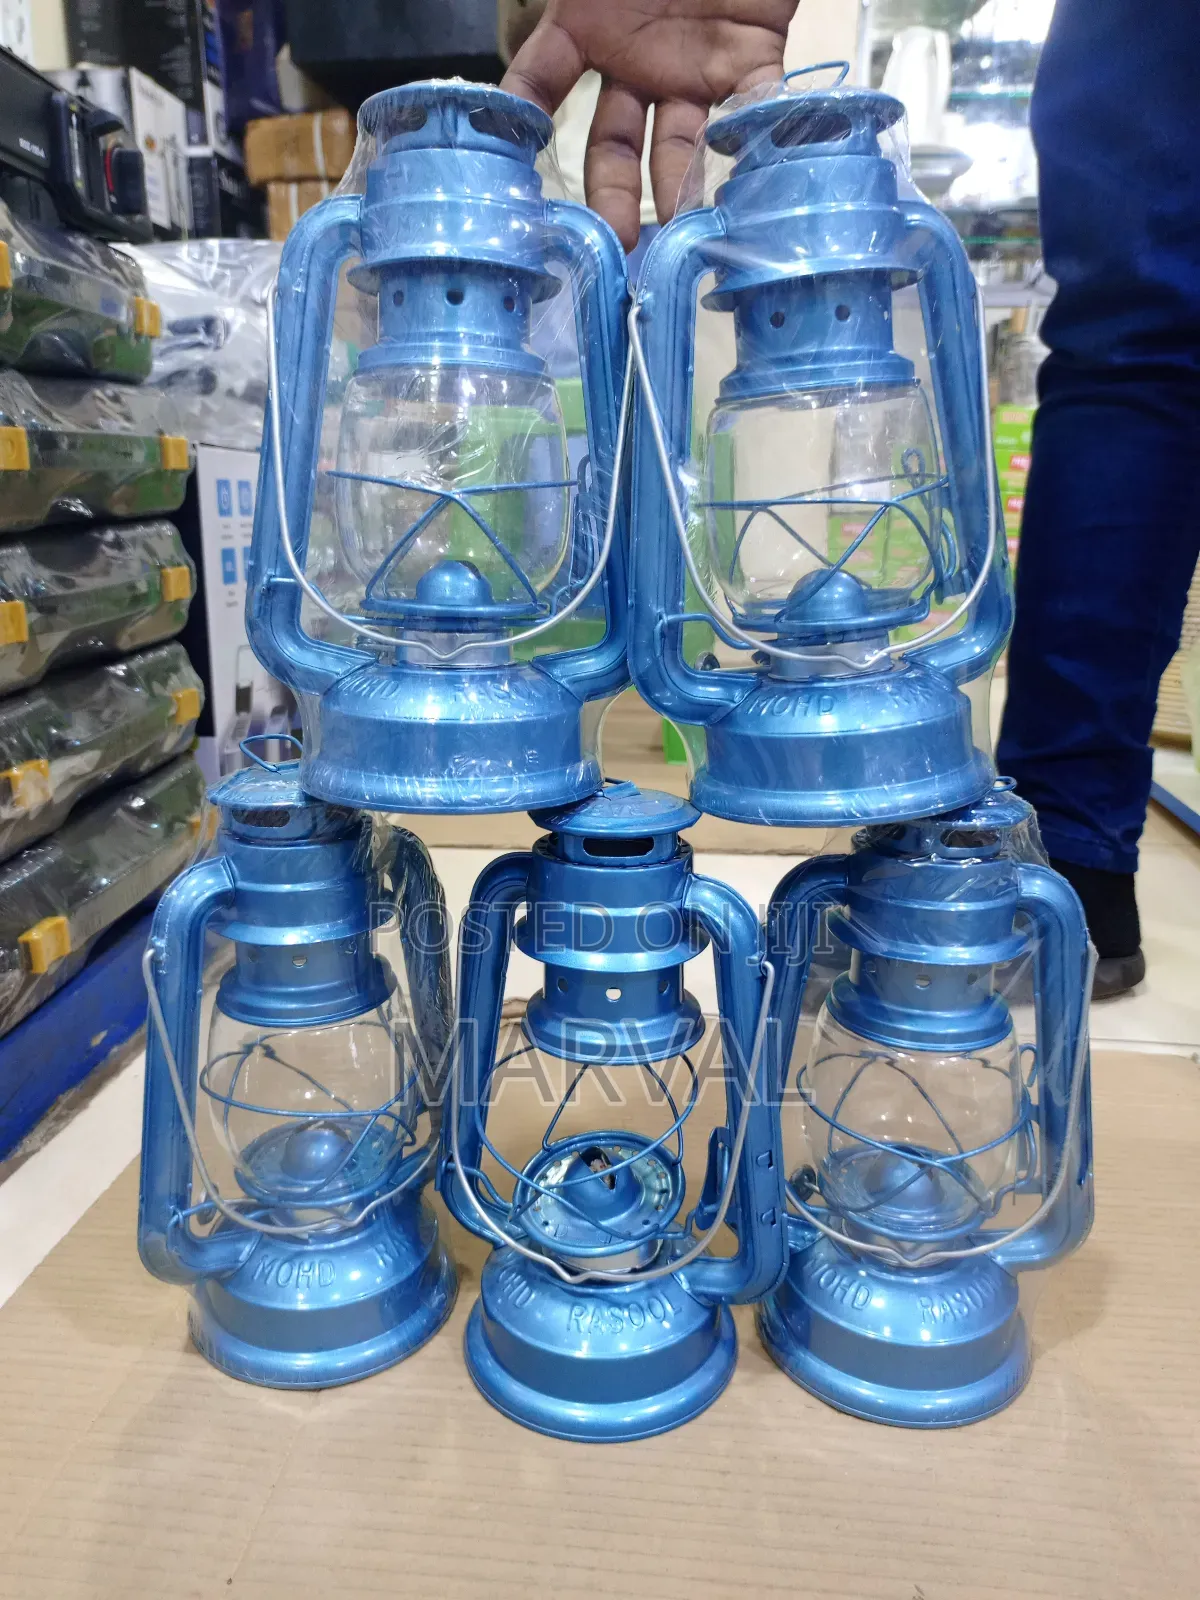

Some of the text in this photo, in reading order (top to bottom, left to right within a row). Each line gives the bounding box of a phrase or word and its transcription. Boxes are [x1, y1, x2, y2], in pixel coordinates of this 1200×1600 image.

[745, 691, 838, 718] MOHD
[252, 1254, 337, 1290] MOHD
[566, 1292, 684, 1336] RASOOL
